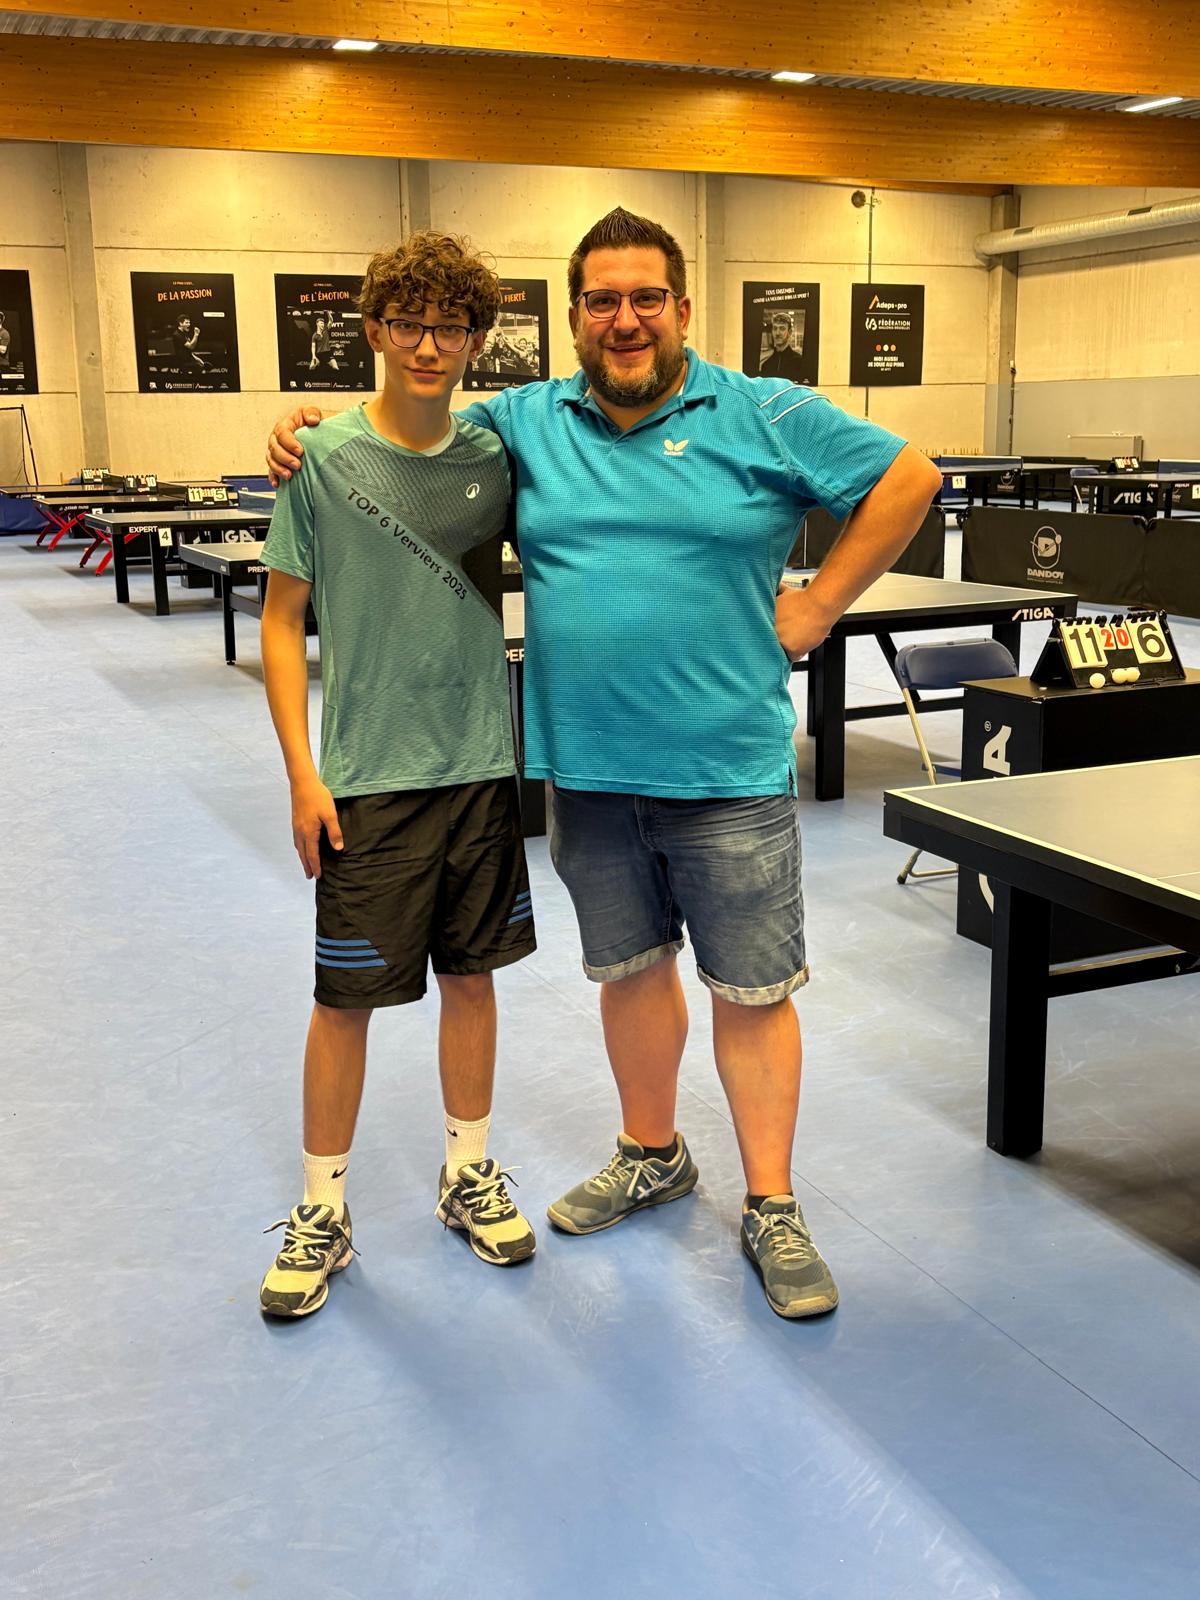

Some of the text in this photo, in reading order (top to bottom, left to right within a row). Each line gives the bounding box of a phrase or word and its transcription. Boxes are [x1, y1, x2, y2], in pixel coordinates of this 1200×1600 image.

[158, 289, 212, 302] DE LA PASSION
[300, 294, 310, 304] DE
[504, 290, 526, 302] FIERTÉ
[878, 318, 910, 326] FÉDÉRATION
[191, 490, 201, 500] 11
[216, 490, 225, 500] 5
[161, 531, 169, 541] 4
[347, 488, 468, 600] TOP 6 Verviers 2025
[1027, 568, 1064, 580] DANDOY
[1012, 607, 1054, 621] STIGA
[1069, 627, 1103, 664] 11
[1136, 623, 1166, 658] 6
